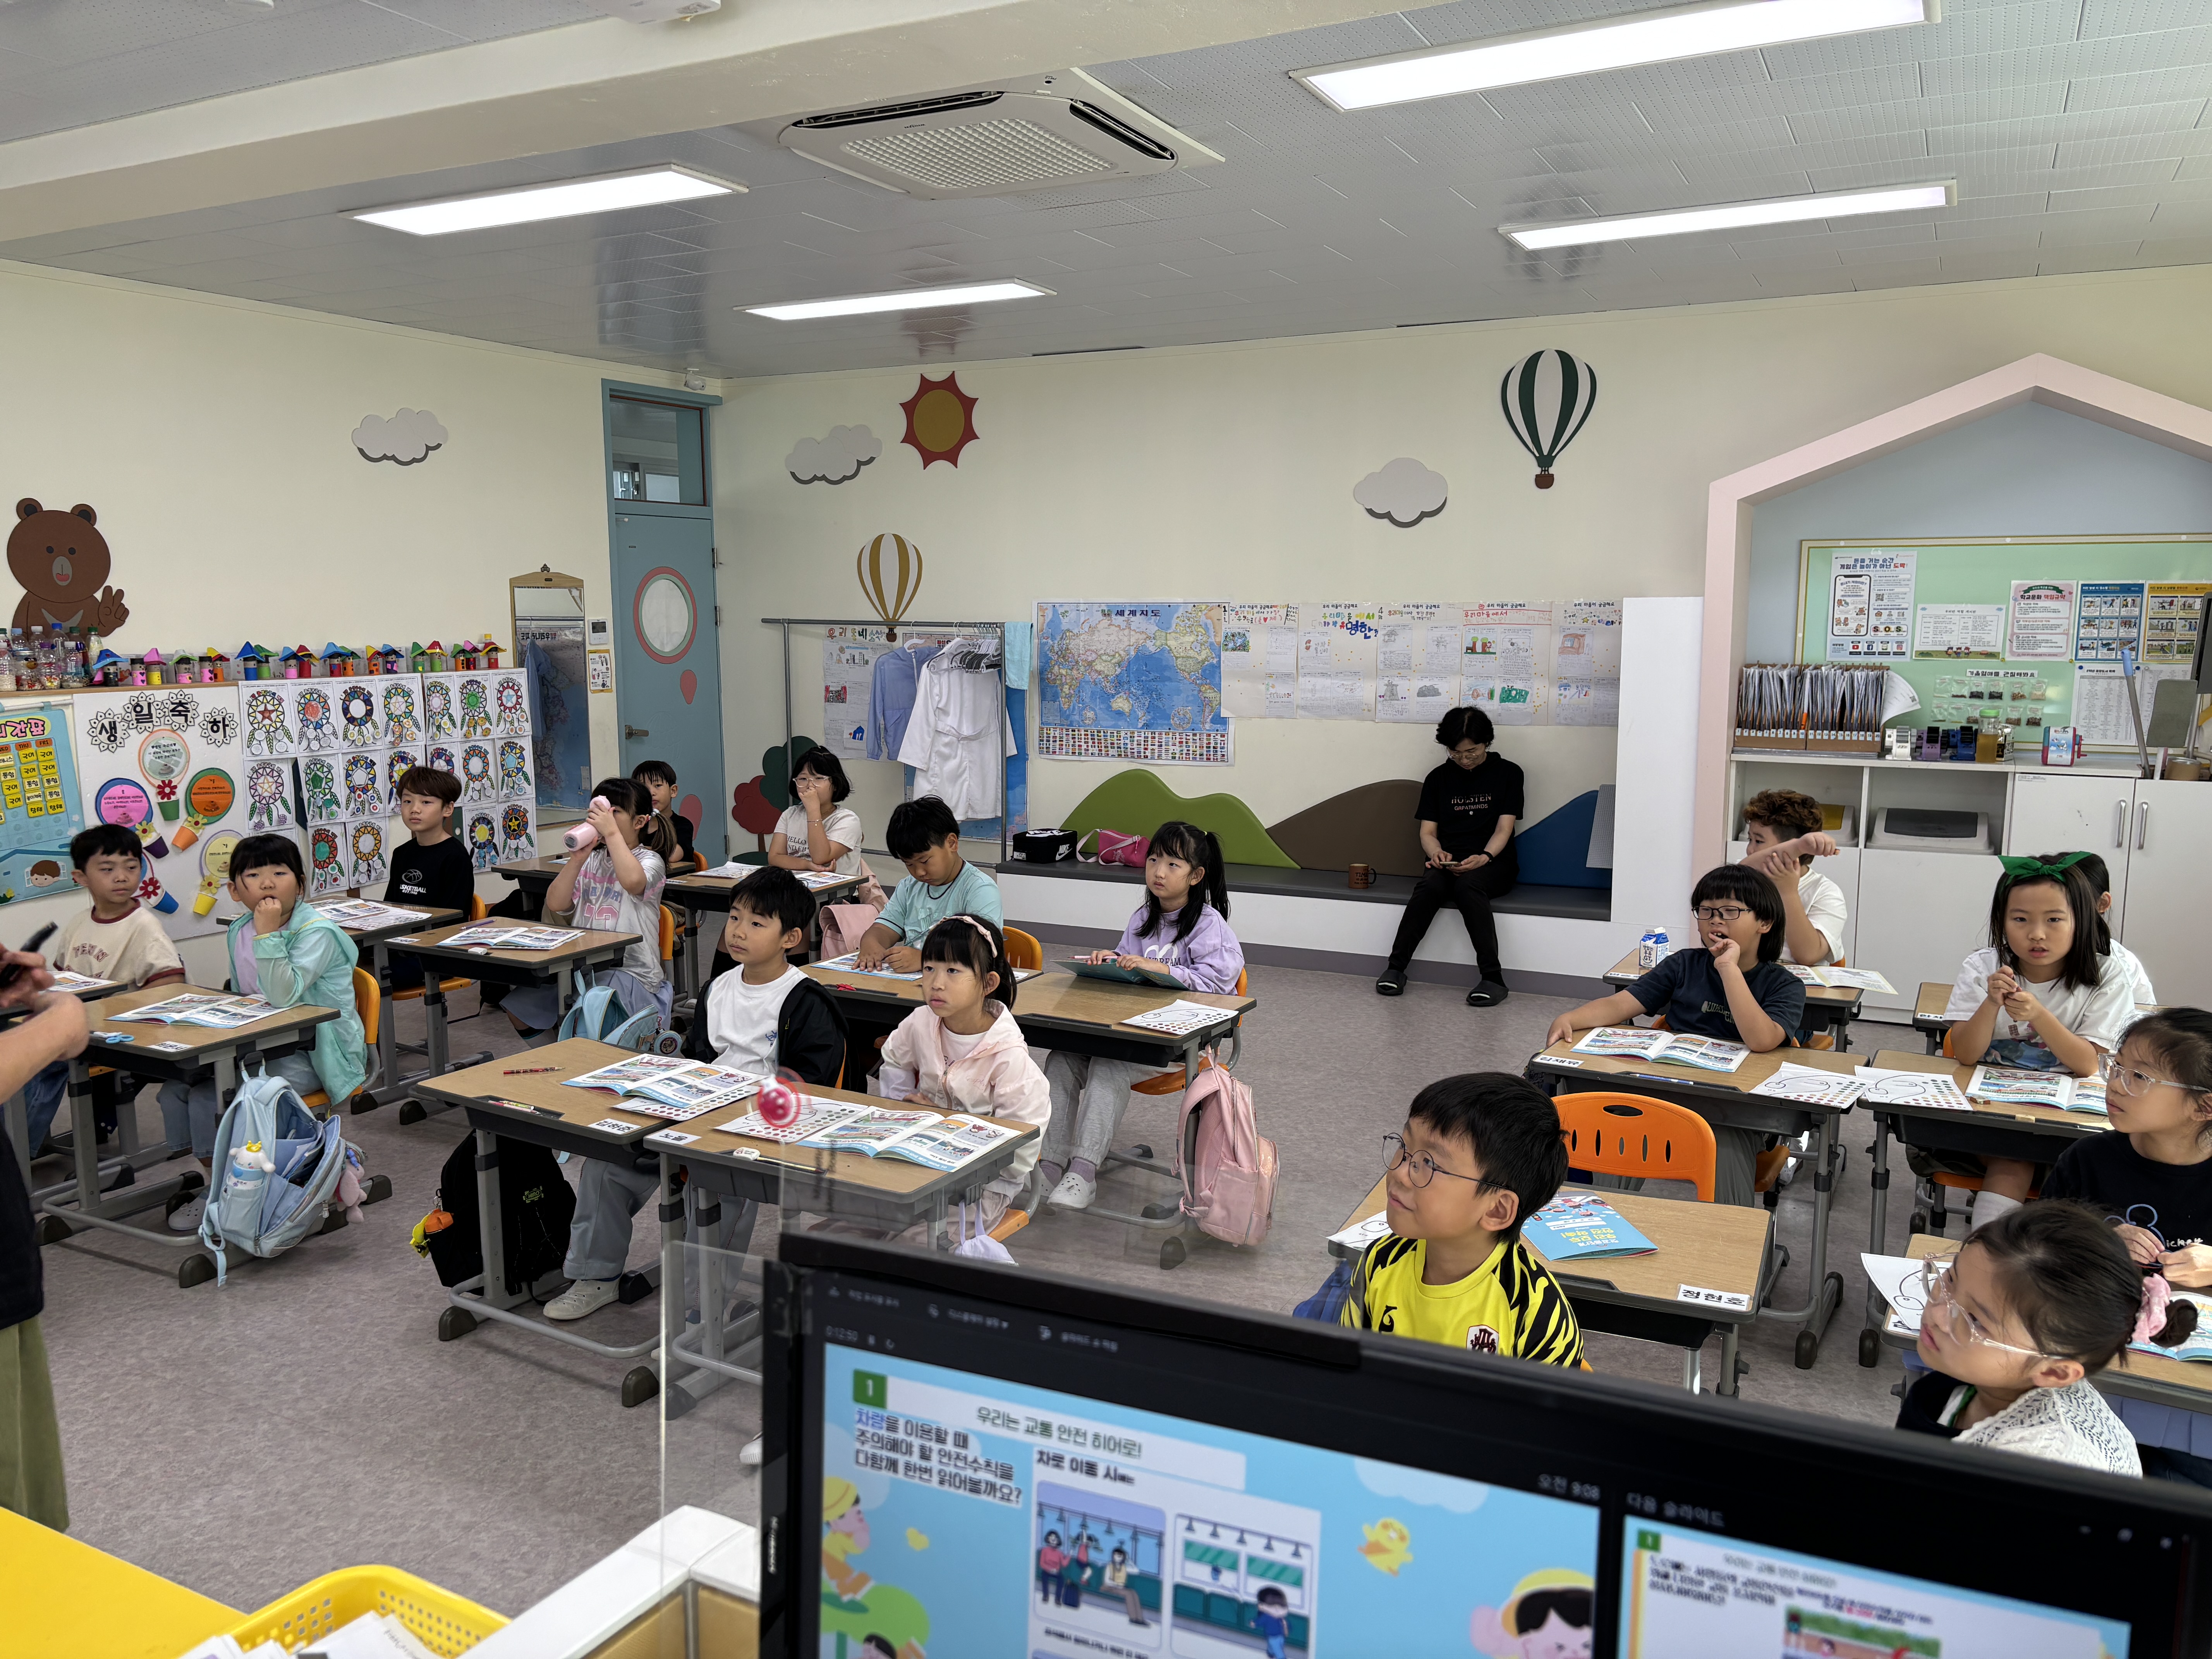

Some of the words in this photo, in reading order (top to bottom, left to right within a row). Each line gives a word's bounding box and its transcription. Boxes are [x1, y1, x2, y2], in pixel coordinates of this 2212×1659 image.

[827, 627, 847, 639] 우리
[852, 628, 867, 641] 동네
[0, 718, 45, 738] 간표
[1058, 844, 1070, 854] NIKE
[659, 1133, 689, 1141] 노을
[2166, 1238, 2203, 1247] ickey
[1682, 1289, 1745, 1307] 정현호
[866, 1379, 874, 1397] 1
[855, 1408, 899, 1434] 차량을
[904, 1419, 949, 1444] 이용할
[954, 1430, 969, 1450] 때
[977, 1407, 1020, 1431] 우리는
[1024, 1416, 1054, 1439] 교통
[1058, 1424, 1087, 1445] 안전
[1092, 1431, 1142, 1459] 히어로!
[855, 1428, 914, 1457] 주의해야
[918, 1443, 933, 1462] 할
[937, 1447, 1015, 1481] 안전수칙을
[1037, 1449, 1065, 1471] 차로
[1070, 1458, 1099, 1478] 이동
[855, 1451, 899, 1475] 다함께
[903, 1460, 933, 1482] 한번
[938, 1468, 1022, 1504] 읽어볼까요?
[1626, 1491, 1657, 1513] 다음
[1662, 1500, 1726, 1528] 슬라이드
